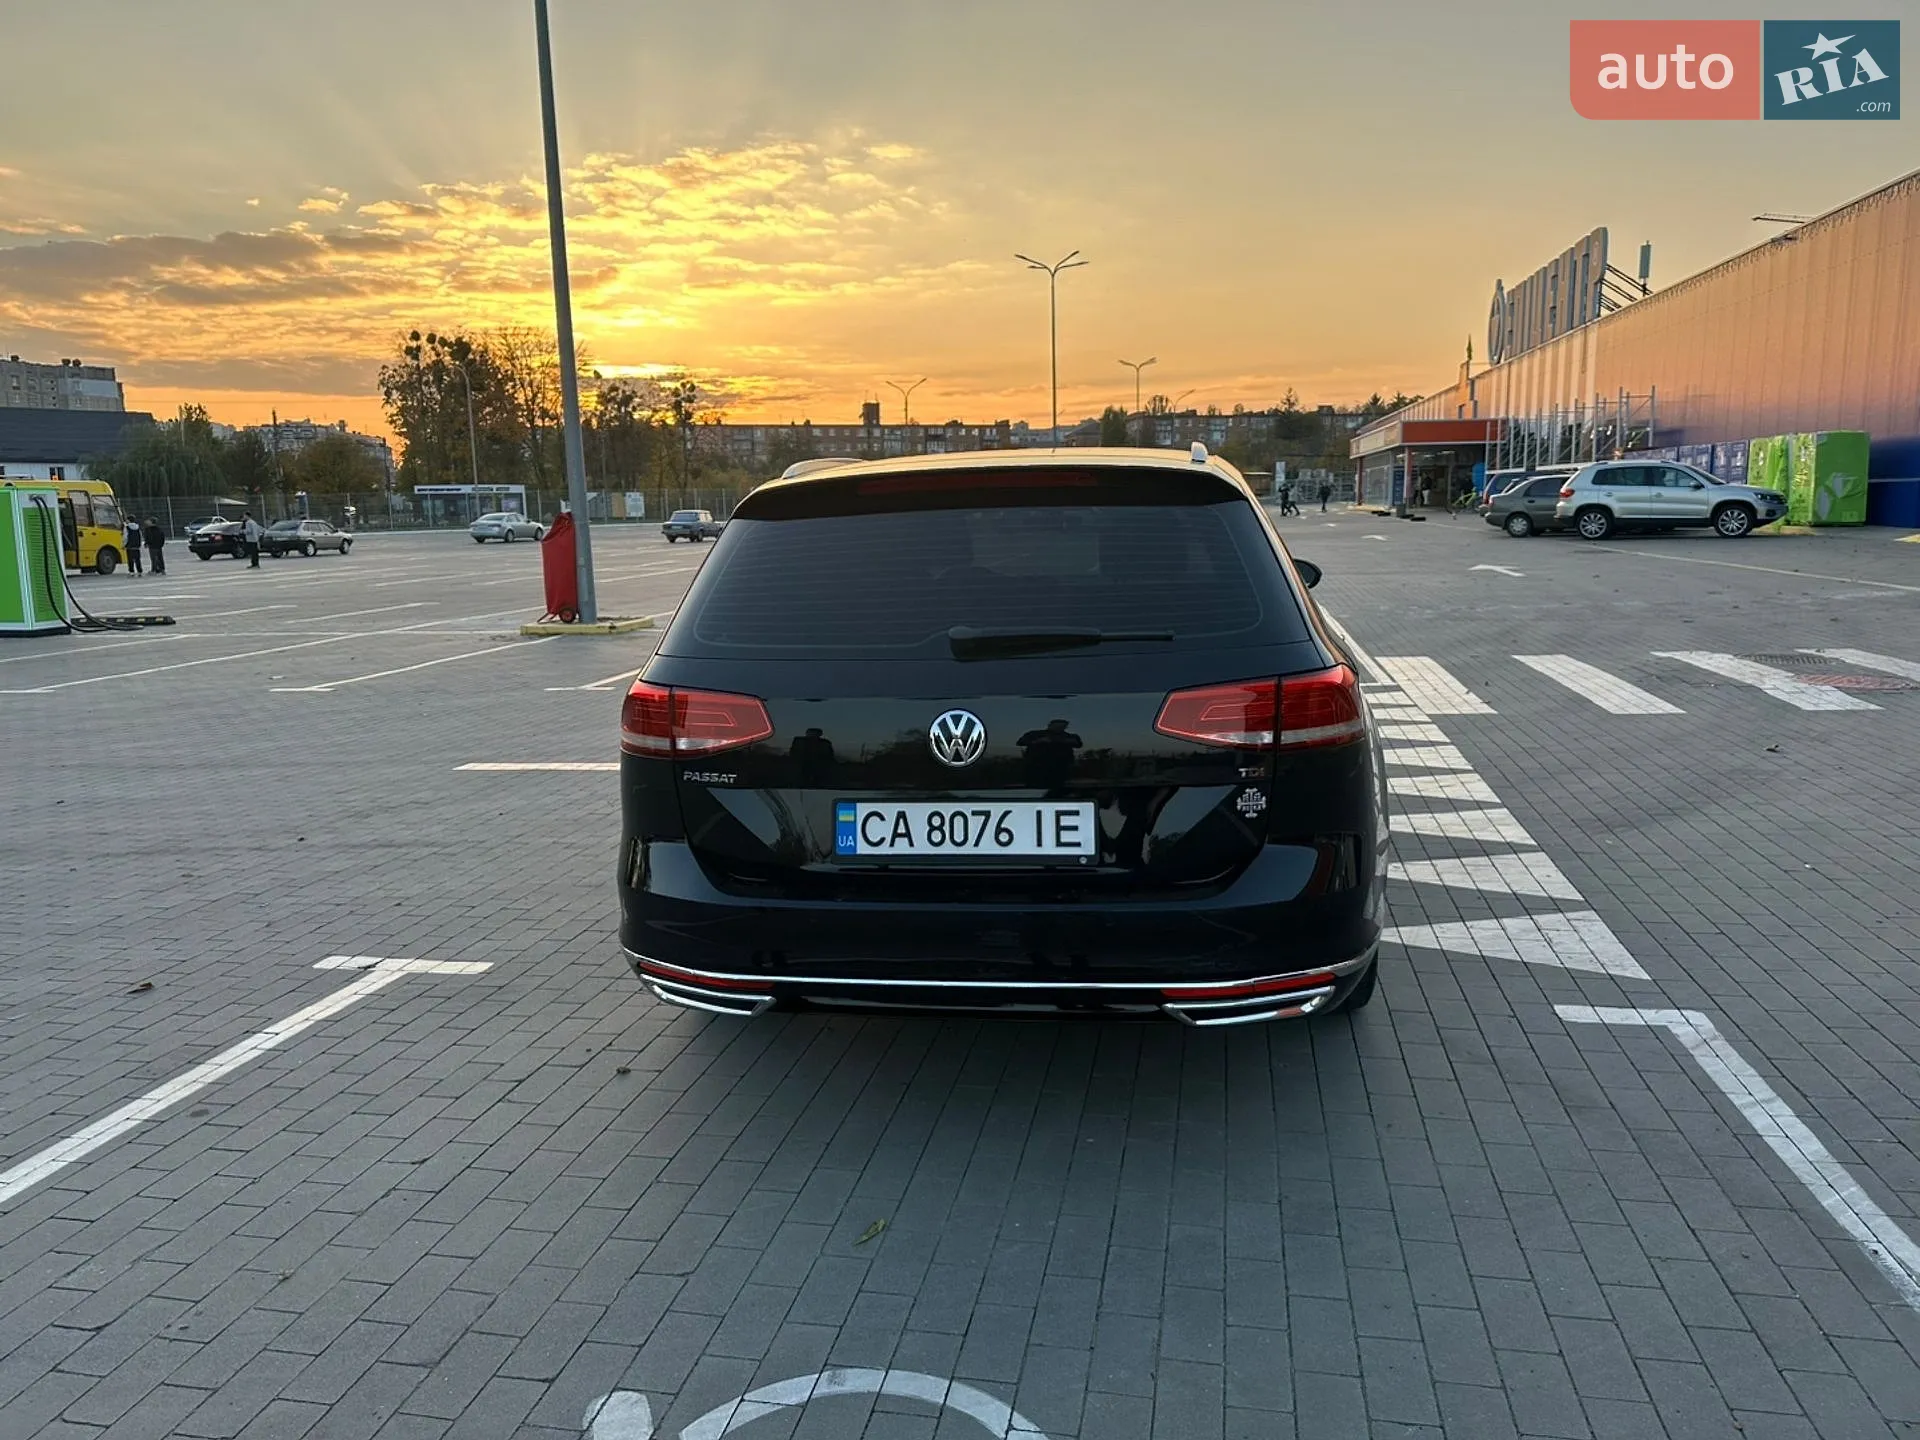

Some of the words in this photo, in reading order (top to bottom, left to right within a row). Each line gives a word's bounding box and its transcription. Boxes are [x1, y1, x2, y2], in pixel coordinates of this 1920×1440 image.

[683, 770, 737, 783] PASSAT
[861, 810, 915, 848] CA
[926, 810, 1015, 848] 8076
[1035, 810, 1083, 848] IE
[838, 835, 855, 847] UA
